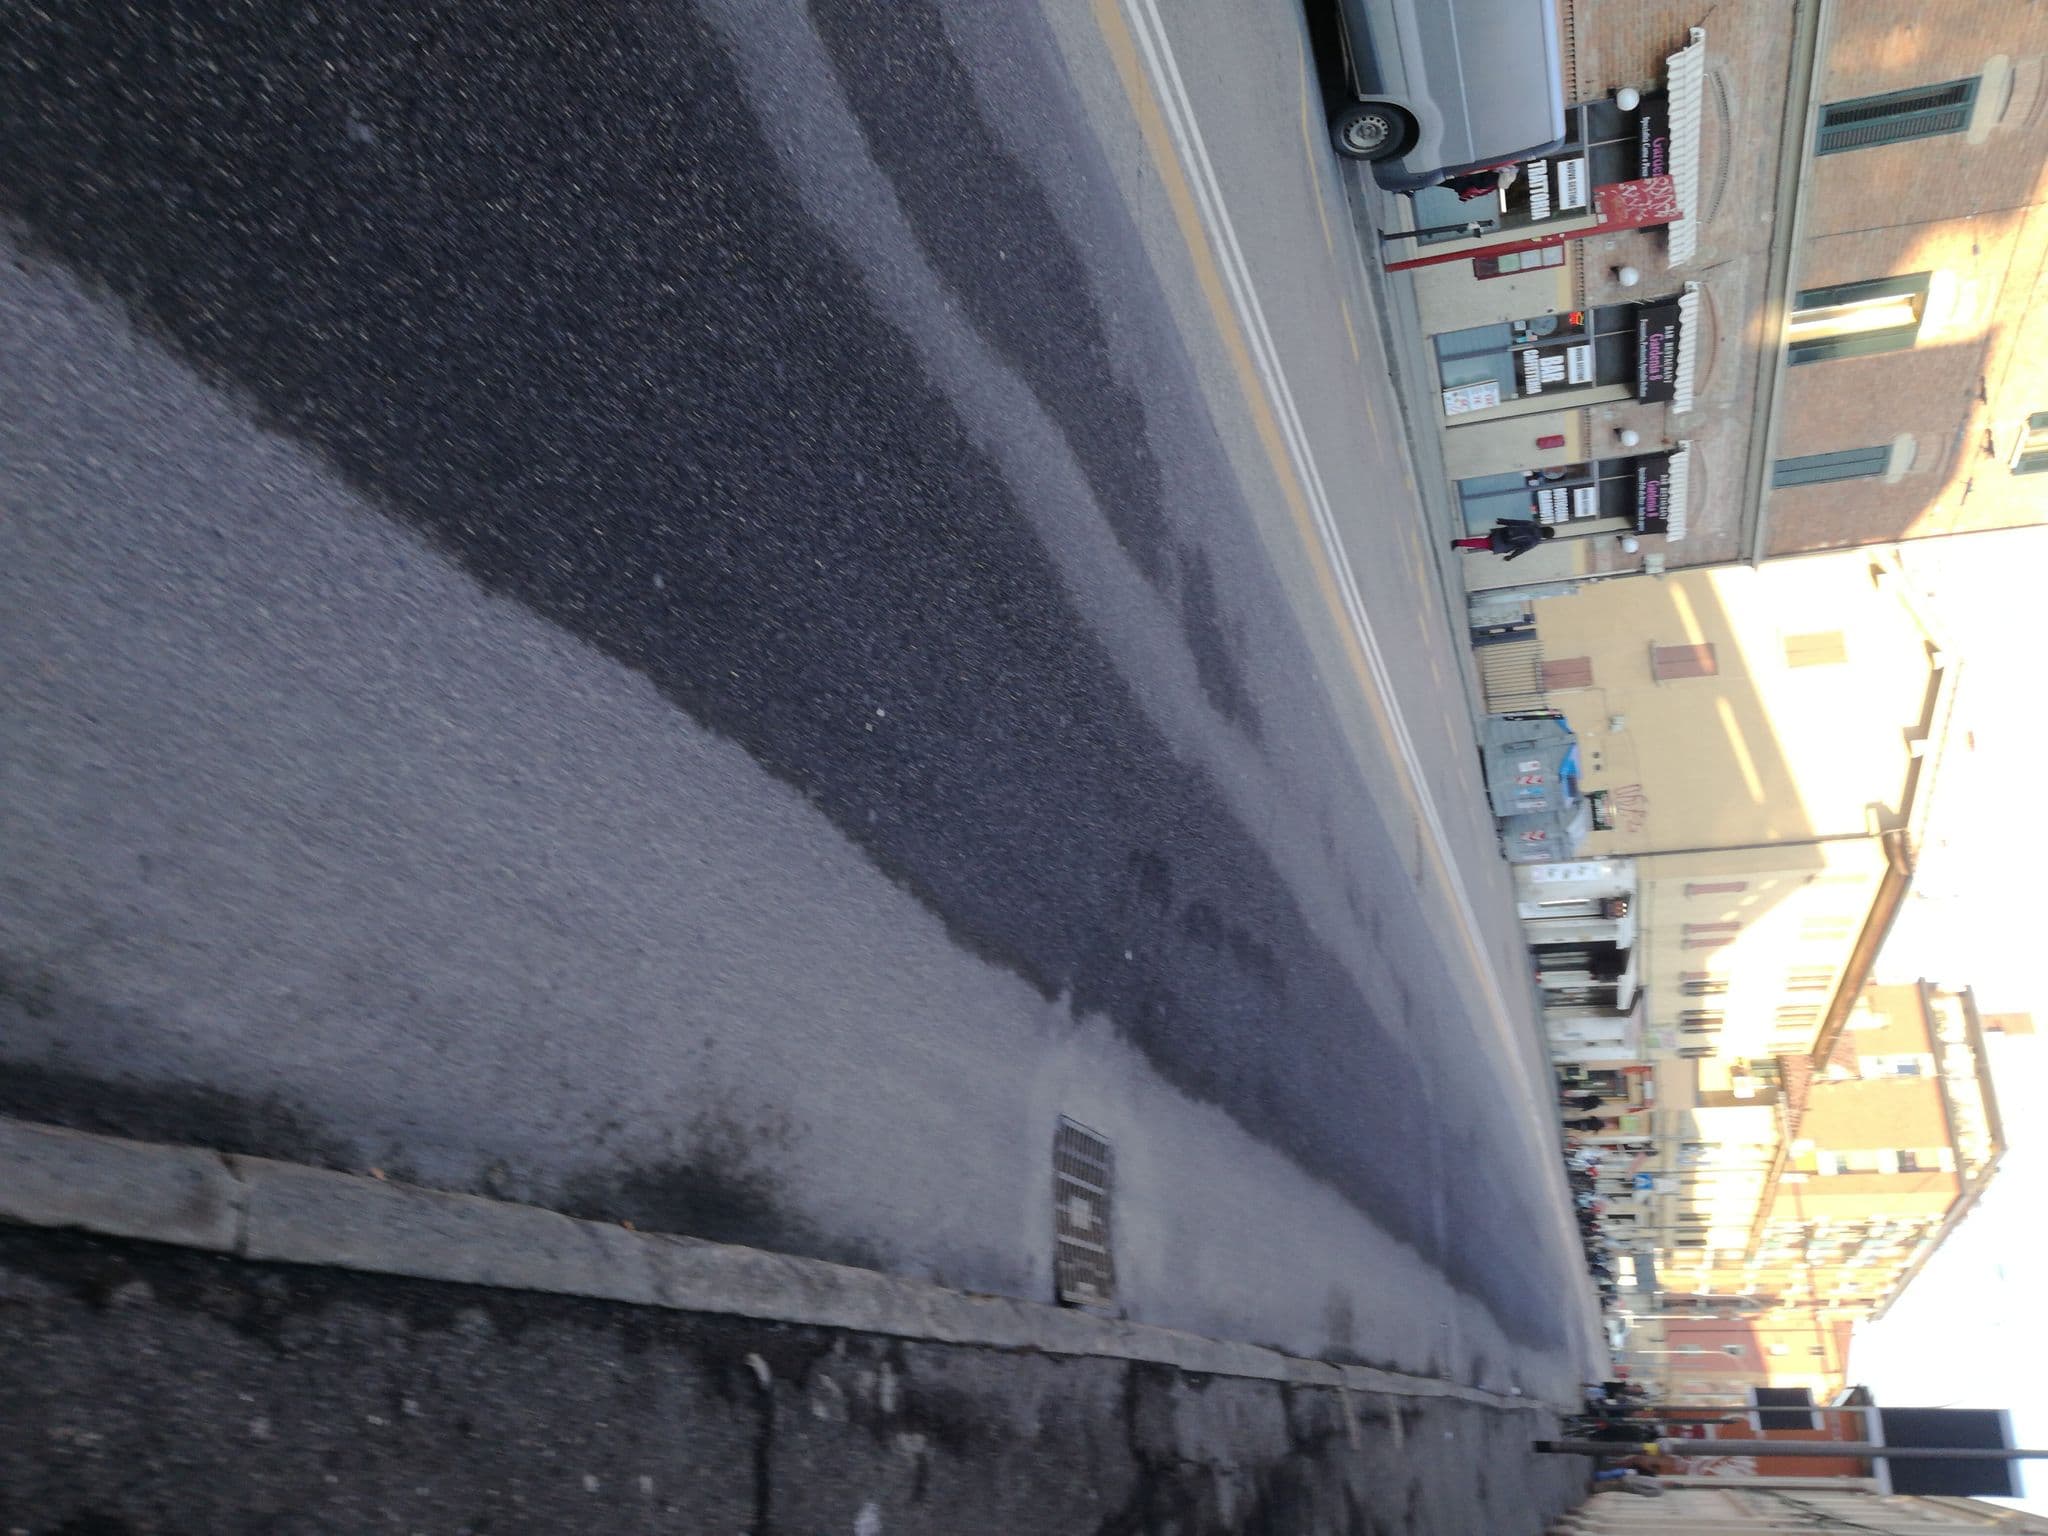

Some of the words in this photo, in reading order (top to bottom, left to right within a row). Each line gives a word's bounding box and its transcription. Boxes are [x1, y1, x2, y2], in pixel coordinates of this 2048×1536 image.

[1526, 160, 1550, 221] TRATTORIA
[1664, 326, 1674, 340] BAR
[1522, 350, 1542, 396] CAFFETTERIA
[1538, 356, 1564, 384] BAR
[1648, 334, 1664, 375] Gardenia
